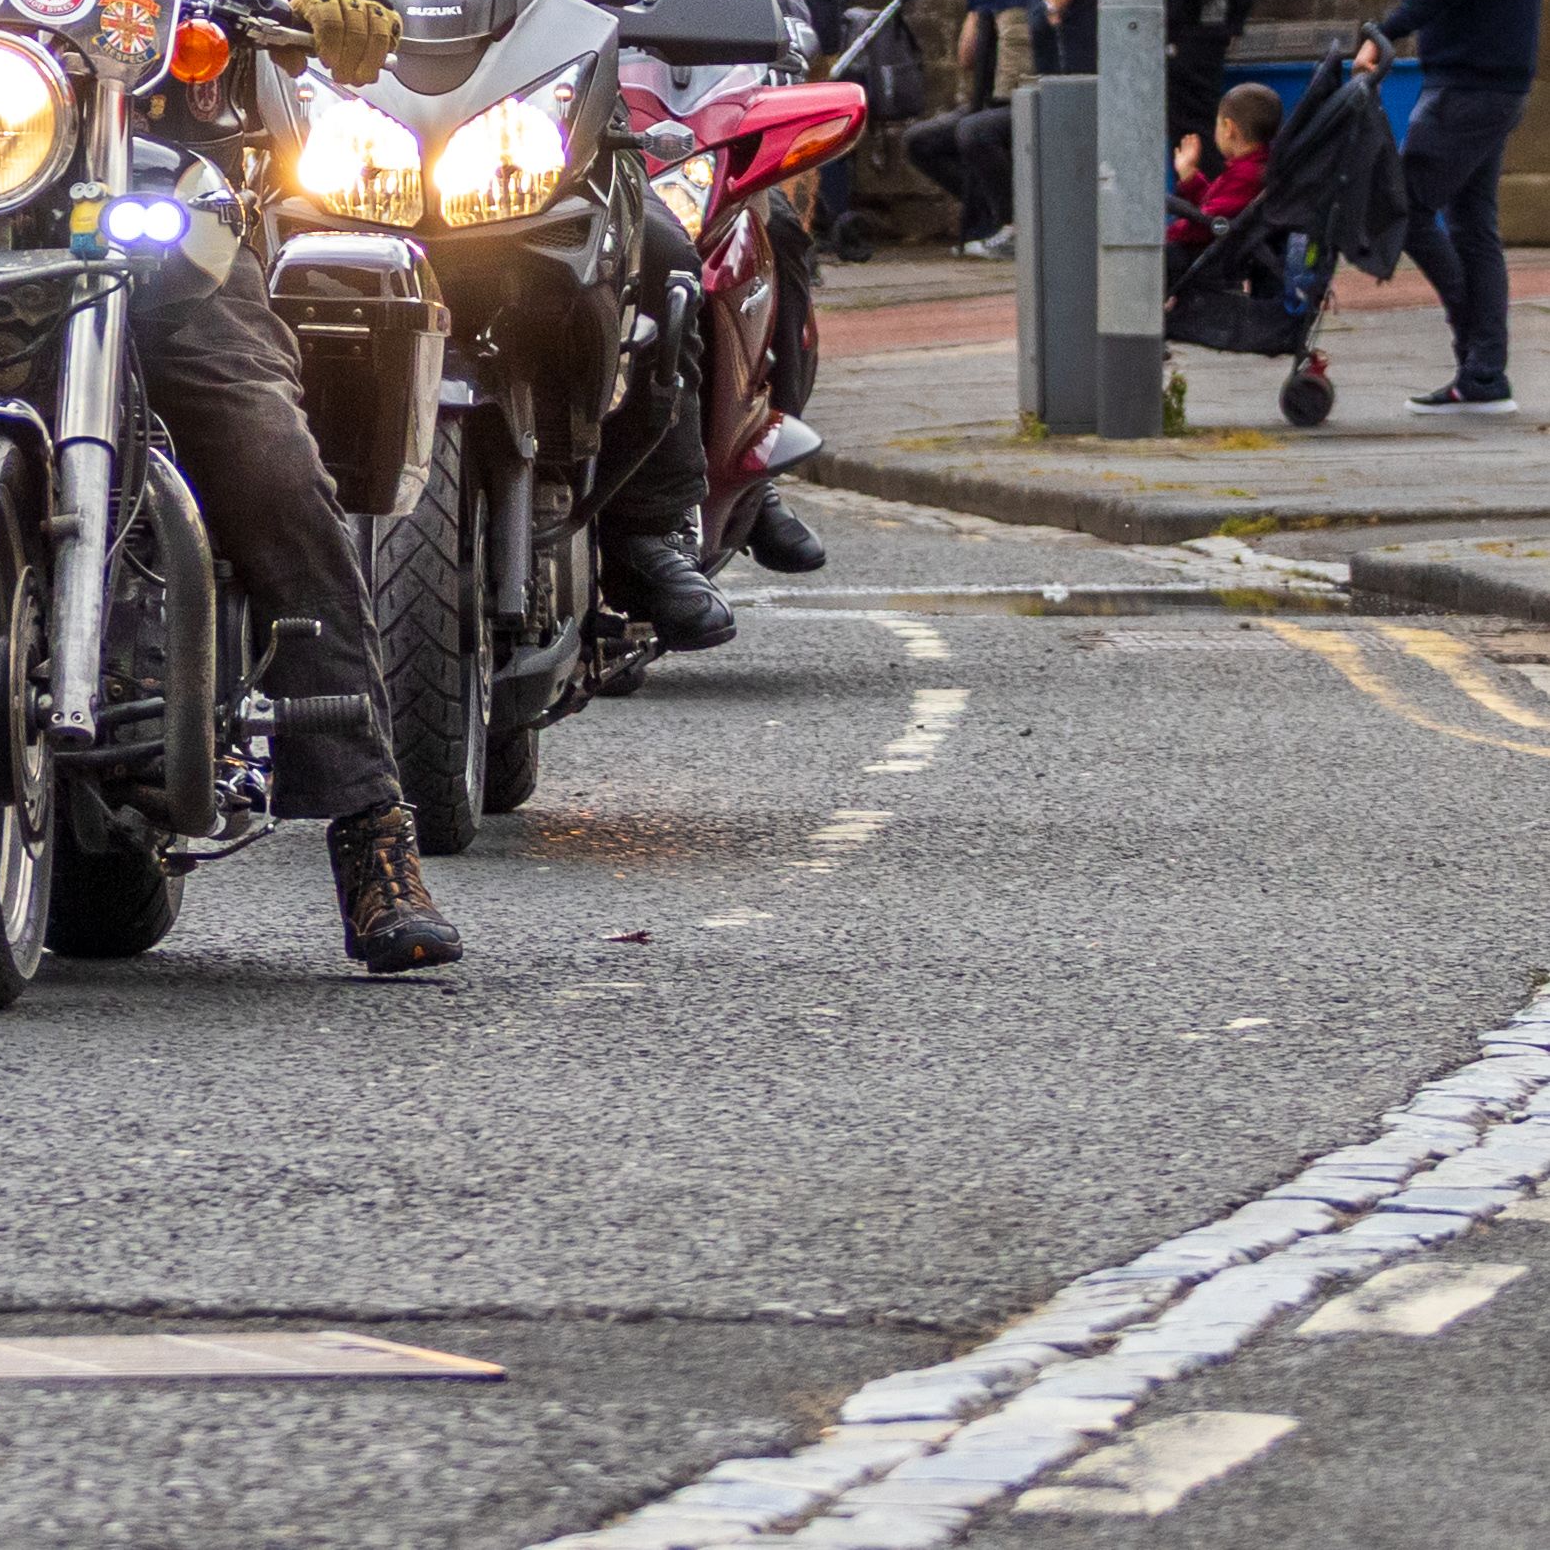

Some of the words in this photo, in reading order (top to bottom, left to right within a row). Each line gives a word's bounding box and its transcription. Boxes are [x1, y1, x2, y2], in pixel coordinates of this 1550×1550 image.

[46, 2, 75, 14] BIKES
[407, 5, 463, 17] SUZUKI
[103, 43, 149, 64] RESPECT
